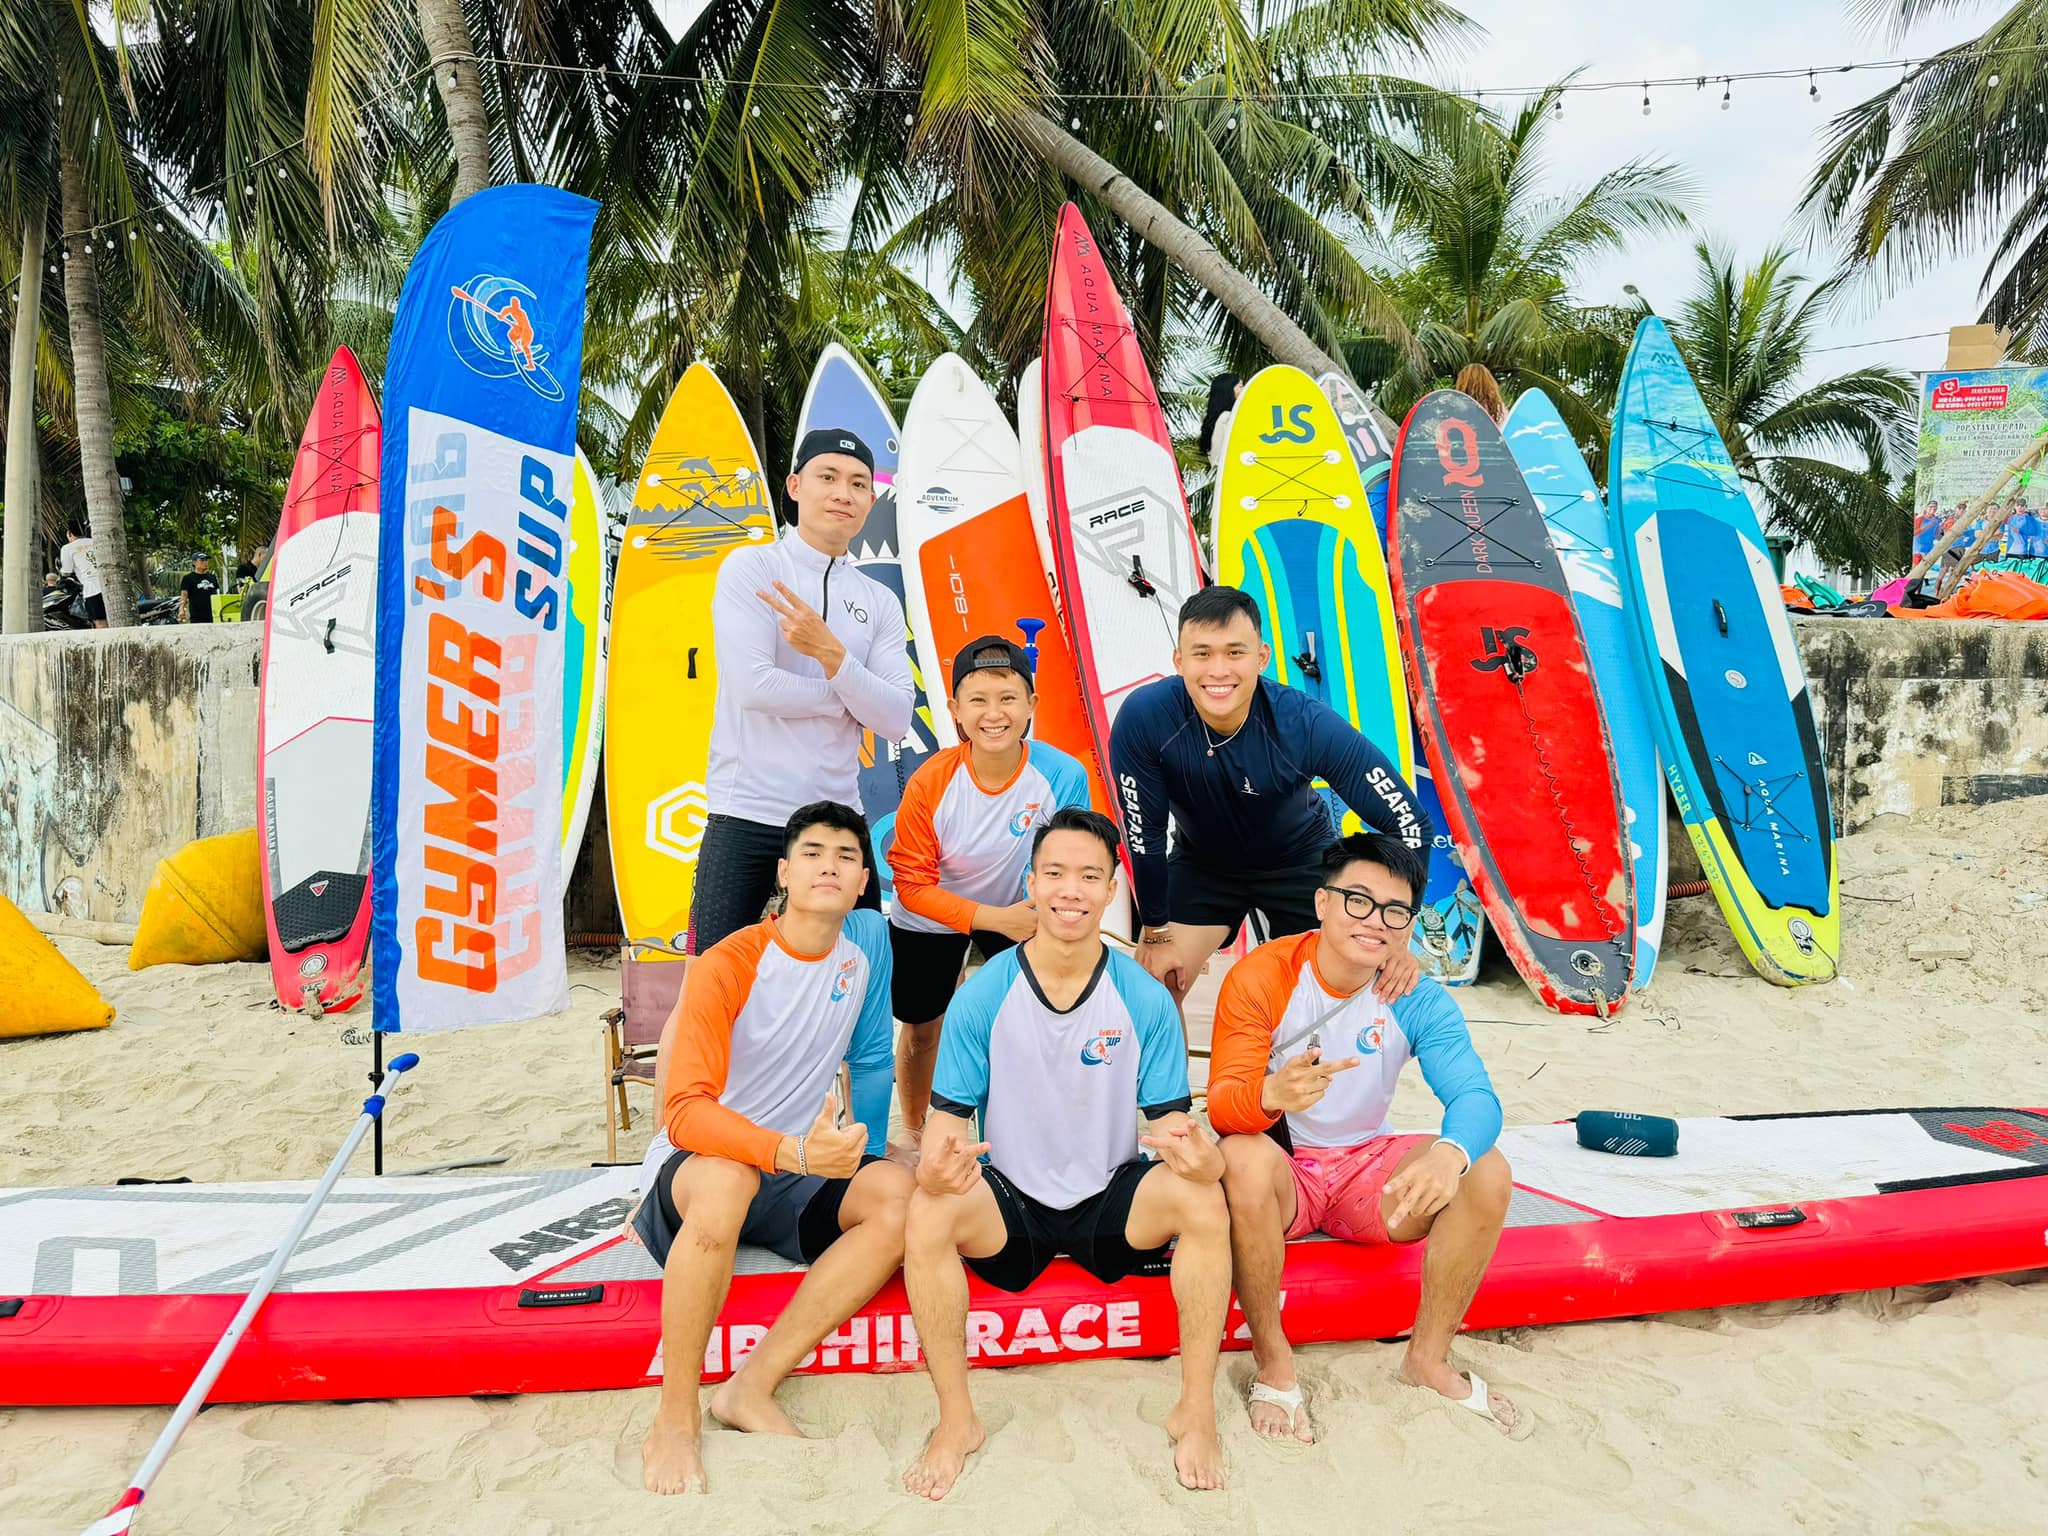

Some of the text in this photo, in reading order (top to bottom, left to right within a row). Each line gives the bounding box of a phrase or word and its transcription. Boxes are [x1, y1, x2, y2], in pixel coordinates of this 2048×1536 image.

[1081, 264, 1113, 398] AQUA MARINA
[331, 391, 344, 494] AQUA MARINA
[922, 494, 959, 502] ADVENTUM
[1089, 500, 1146, 529] RACE
[1460, 489, 1493, 574] DARK QUEEN
[515, 454, 567, 631] SUP
[290, 564, 352, 607] RACE
[415, 505, 507, 994] GYMER'S
[266, 790, 274, 815] AQUA
[1668, 764, 1693, 814] HYPER
[1758, 778, 1791, 876] AQUA MARINA
[965, 1301, 1142, 1357] RACE
